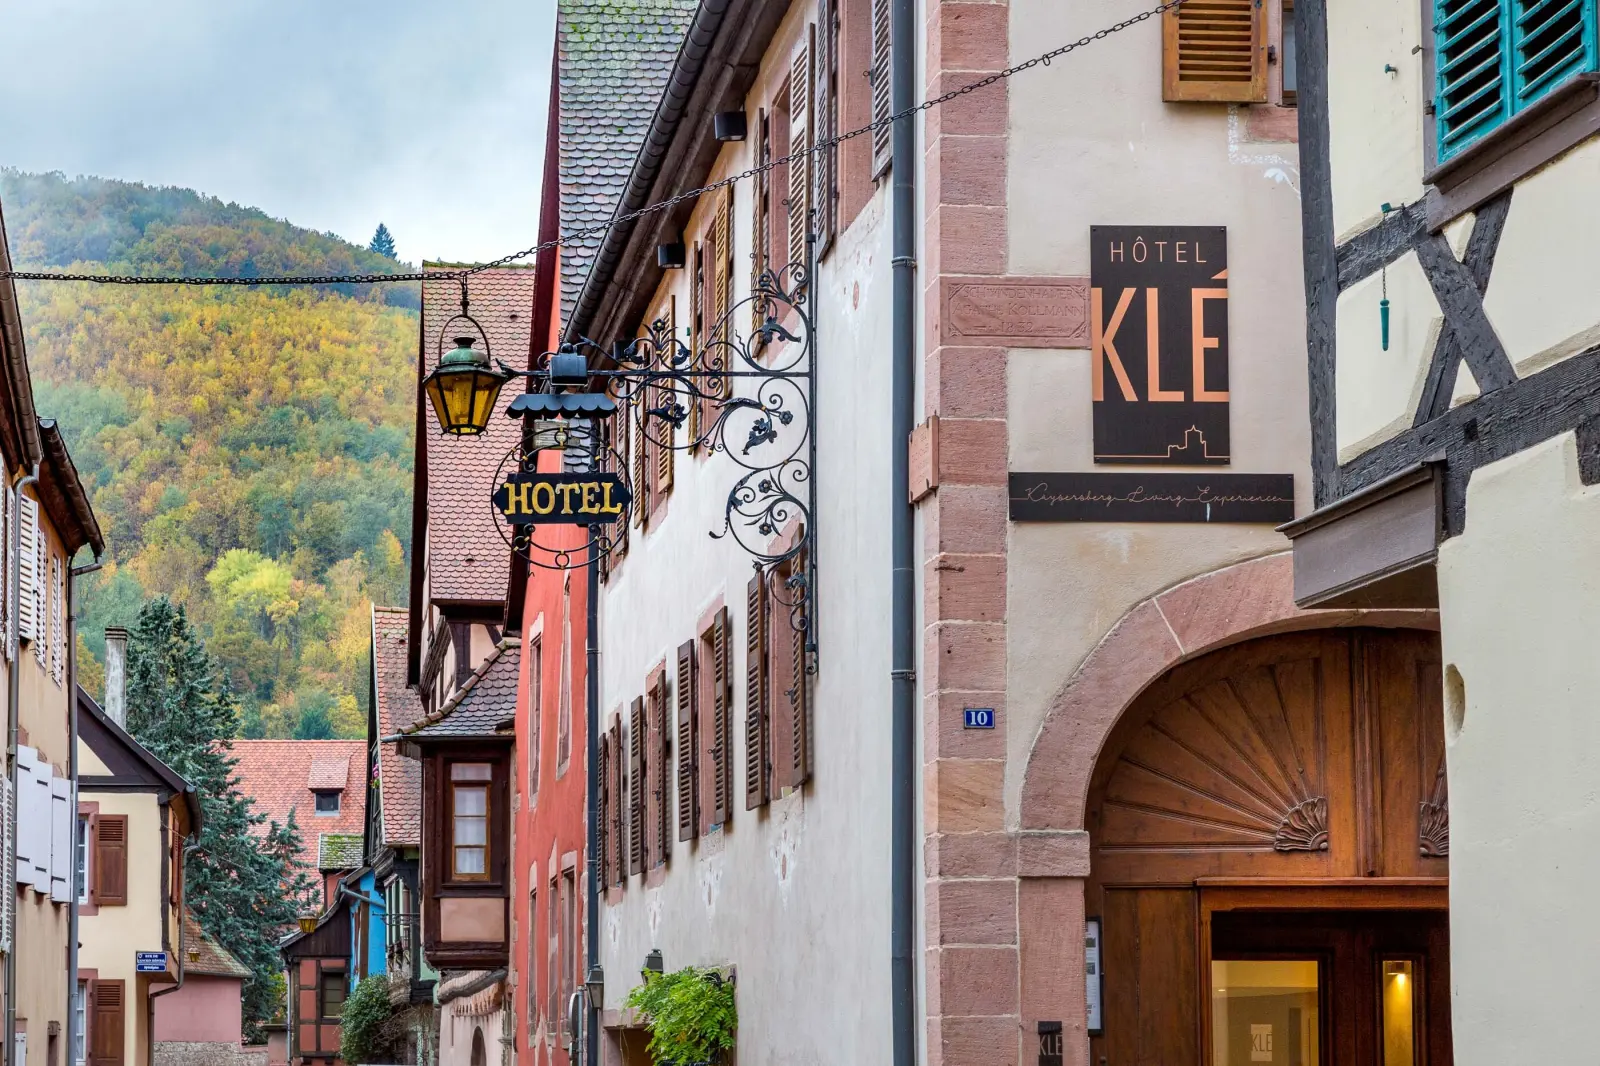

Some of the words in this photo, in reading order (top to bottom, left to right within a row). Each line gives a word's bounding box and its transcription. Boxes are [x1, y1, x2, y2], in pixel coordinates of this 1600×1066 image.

[1110, 235, 1207, 263] HÔTEL
[1091, 268, 1230, 402] KLÉ
[503, 481, 623, 515] HOTEL
[1025, 482, 1116, 508] Kaysersberg
[1128, 485, 1184, 508] Living
[1197, 486, 1282, 507] Experience
[970, 711, 988, 726] 10
